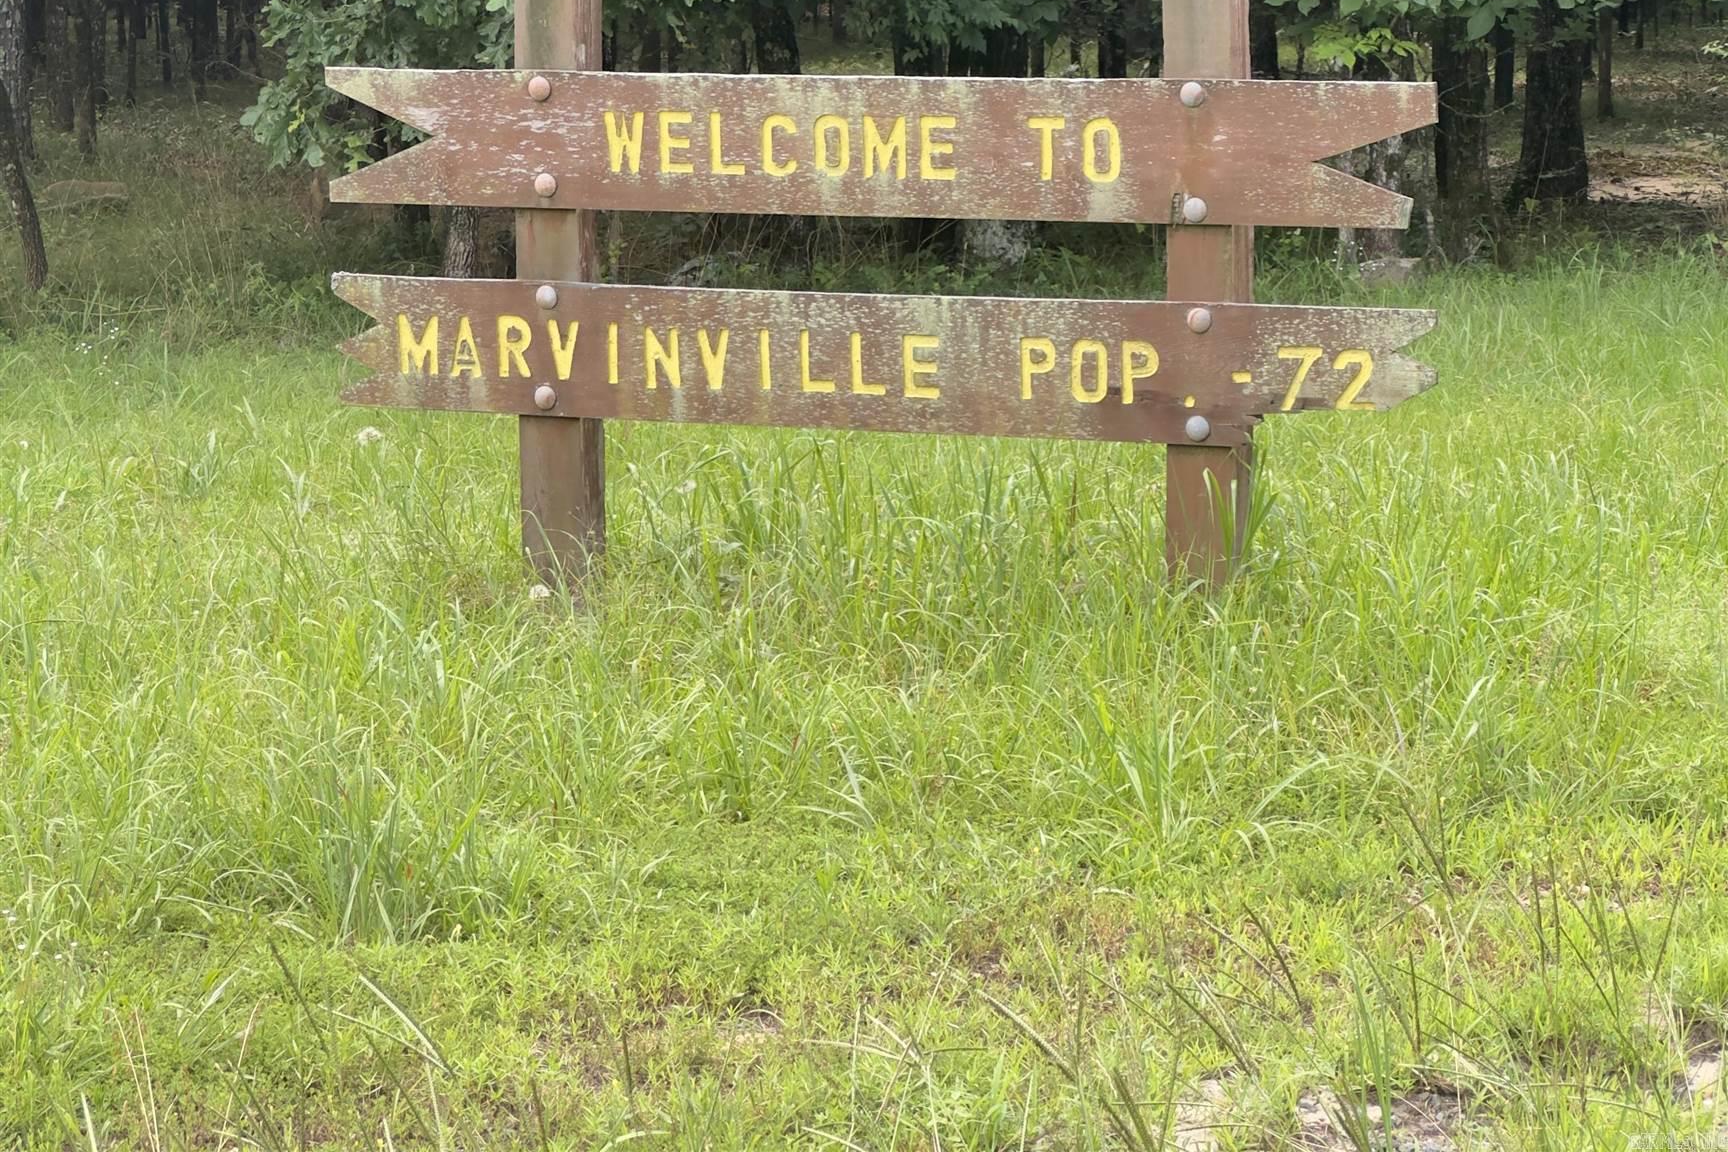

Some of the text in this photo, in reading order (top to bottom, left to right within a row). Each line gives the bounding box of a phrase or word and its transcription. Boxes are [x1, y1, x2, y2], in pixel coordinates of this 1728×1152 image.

[603, 110, 1121, 182] WELCOME TO
[398, 313, 940, 398] MARVINVILLE
